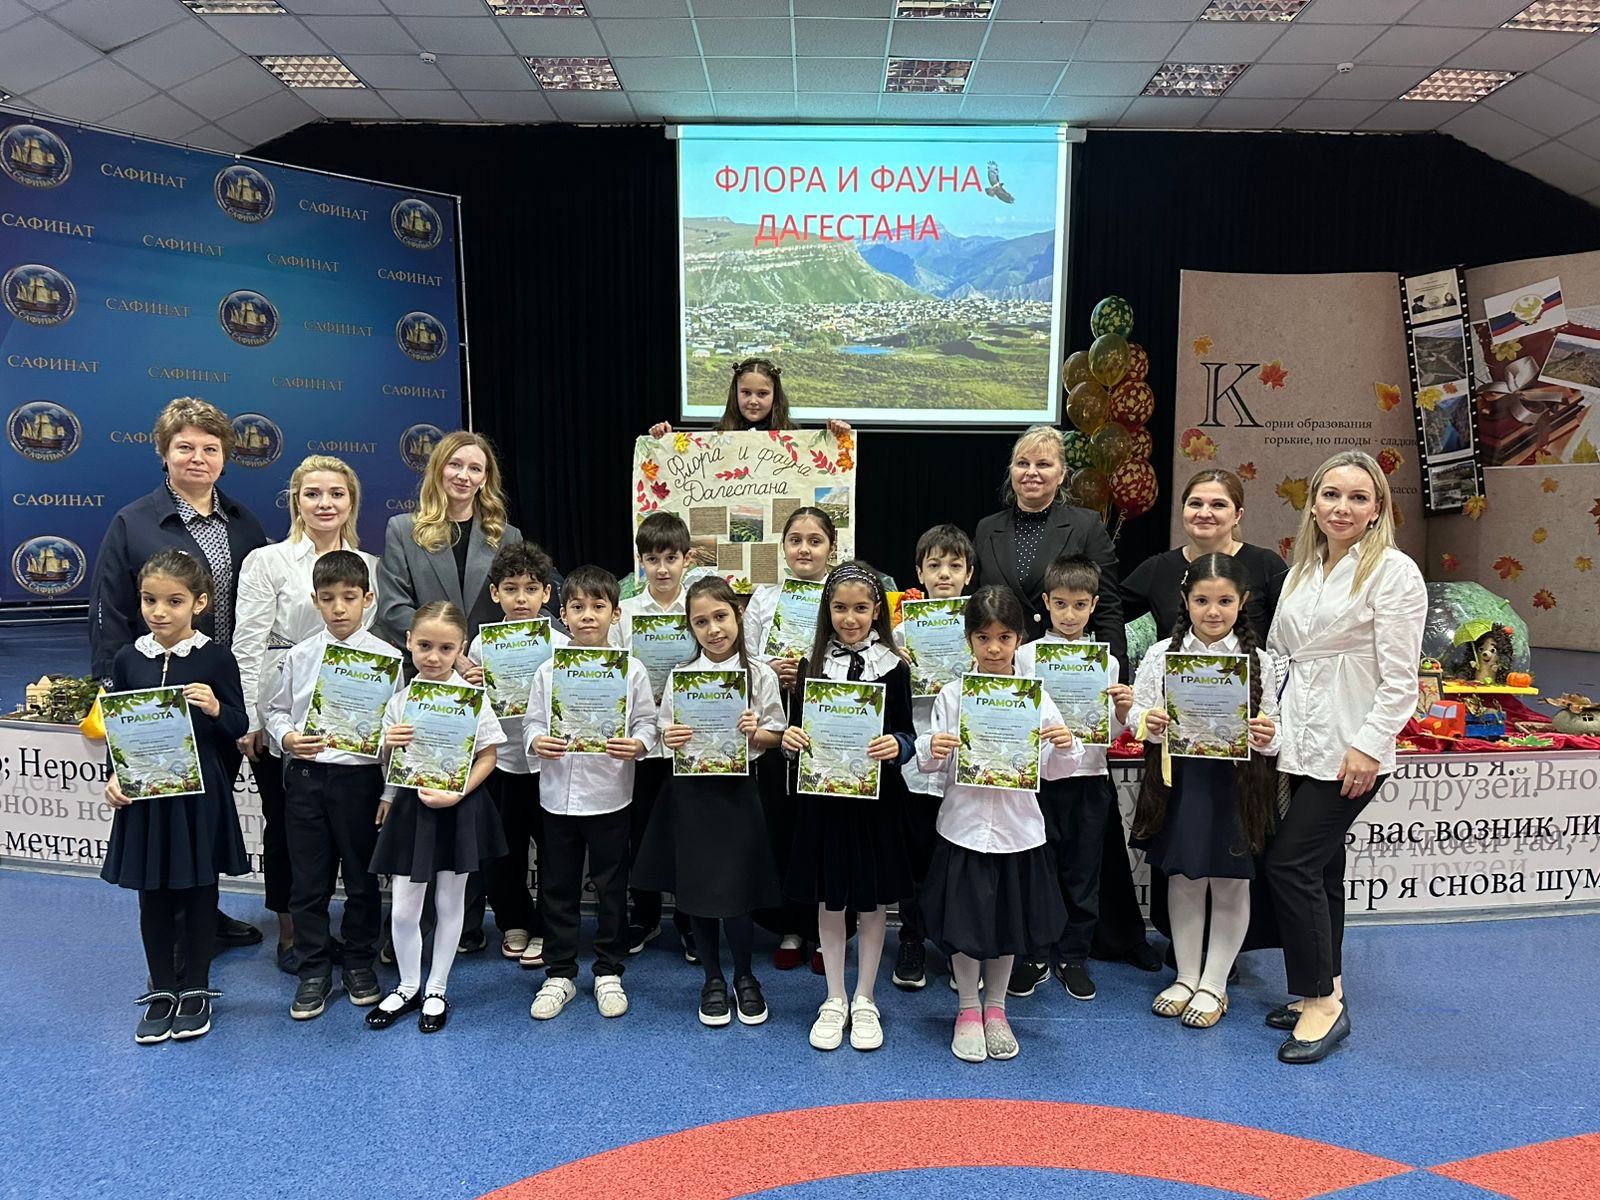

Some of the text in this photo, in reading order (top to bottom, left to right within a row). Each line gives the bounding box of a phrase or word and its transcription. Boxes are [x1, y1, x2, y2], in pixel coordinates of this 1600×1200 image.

[101, 163, 187, 190] САФИНАТ
[715, 164, 983, 193] ФЛОРА И ФАУНА
[299, 199, 369, 222] САФИНАТ
[1, 213, 95, 239] САФИНАТ
[754, 213, 940, 248] ДАГЕСТАНА
[143, 234, 225, 258] САФИНАТ
[267, 253, 340, 273] САФИНАТ
[377, 268, 443, 288] САФИНАТ
[106, 298, 191, 319] САФИНАТ
[304, 320, 375, 338] САФИНАТ
[8, 354, 100, 374] САФИНАТ
[148, 366, 231, 384] САФИНАТ
[272, 375, 344, 392] САФИНАТ
[382, 384, 448, 400] САФИНАТ
[1297, 418, 1372, 431] образования
[307, 439, 378, 454] САФИНАТ
[1264, 436, 1313, 448] горькие,
[1316, 437, 1331, 445] но
[1334, 437, 1371, 447] плоды
[667, 446, 812, 489] Флора и фауна
[683, 478, 789, 507] Дагестана
[1390, 486, 1418, 495] кассо
[13, 493, 105, 508] САФИНАТ
[792, 594, 820, 604] ГРАМО
[917, 617, 960, 628] ГРАМОТА
[495, 639, 539, 651] ГРАМОТА
[645, 633, 687, 642] ГРАМОТА
[334, 667, 383, 683] ГРАМОТА
[567, 670, 615, 679] ГРАМОТА
[1048, 663, 1095, 672] ГРАМОТА
[1181, 675, 1233, 686] ГРАМОТА
[687, 692, 733, 701] ГРАМОТА
[976, 697, 1026, 709] ГРАМОТА
[121, 711, 175, 724] ГРАМОТА
[418, 703, 466, 717] ГРАМОТА
[819, 704, 868, 716] ГРАМОТА
[1534, 760, 1600, 791] Вно
[1408, 767, 1539, 812] друзей.
[0, 794, 69, 819] новь
[1367, 821, 1425, 844] вас
[1434, 816, 1554, 842] возник
[1397, 877, 1418, 898] я
[1429, 871, 1527, 898] снова
